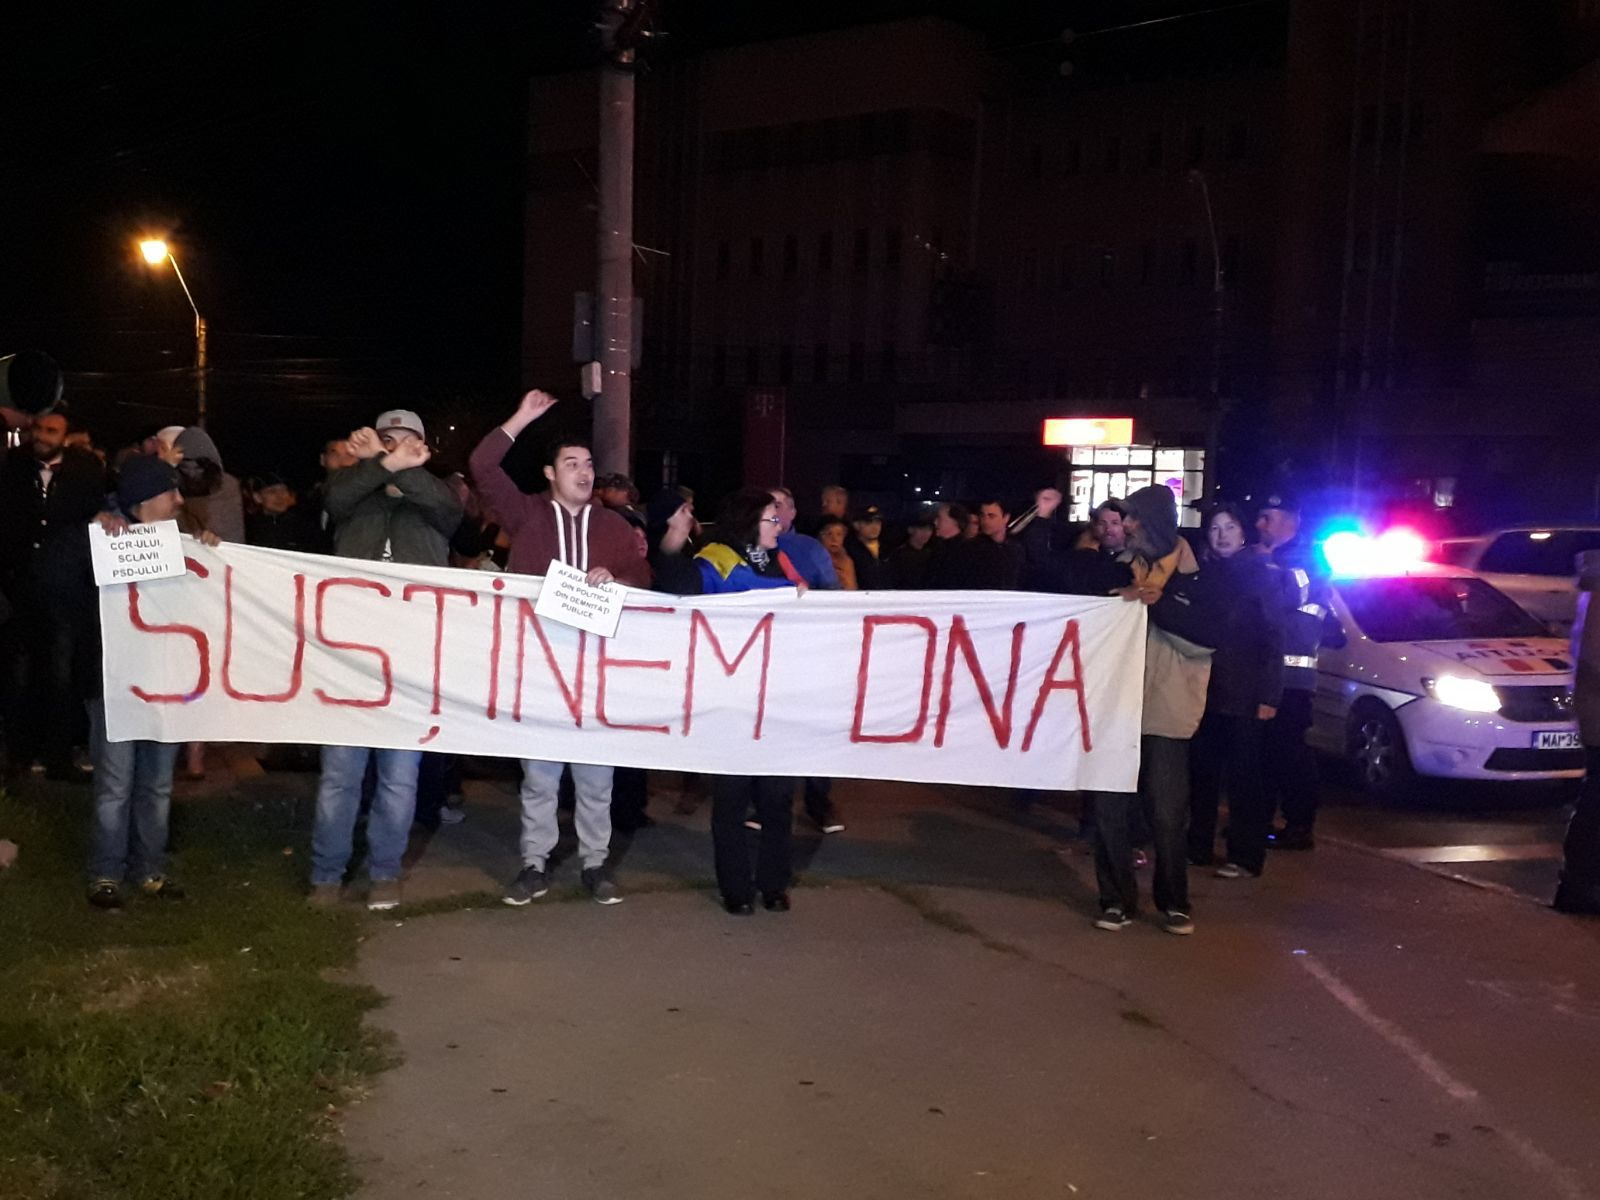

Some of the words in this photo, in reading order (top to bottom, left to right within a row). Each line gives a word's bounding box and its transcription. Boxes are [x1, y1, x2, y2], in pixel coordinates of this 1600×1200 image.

[118, 552, 159, 563] SCLAVII
[112, 566, 162, 578] PSD-ULUI
[561, 602, 593, 618] PUBLICE
[849, 614, 1092, 752] DNA
